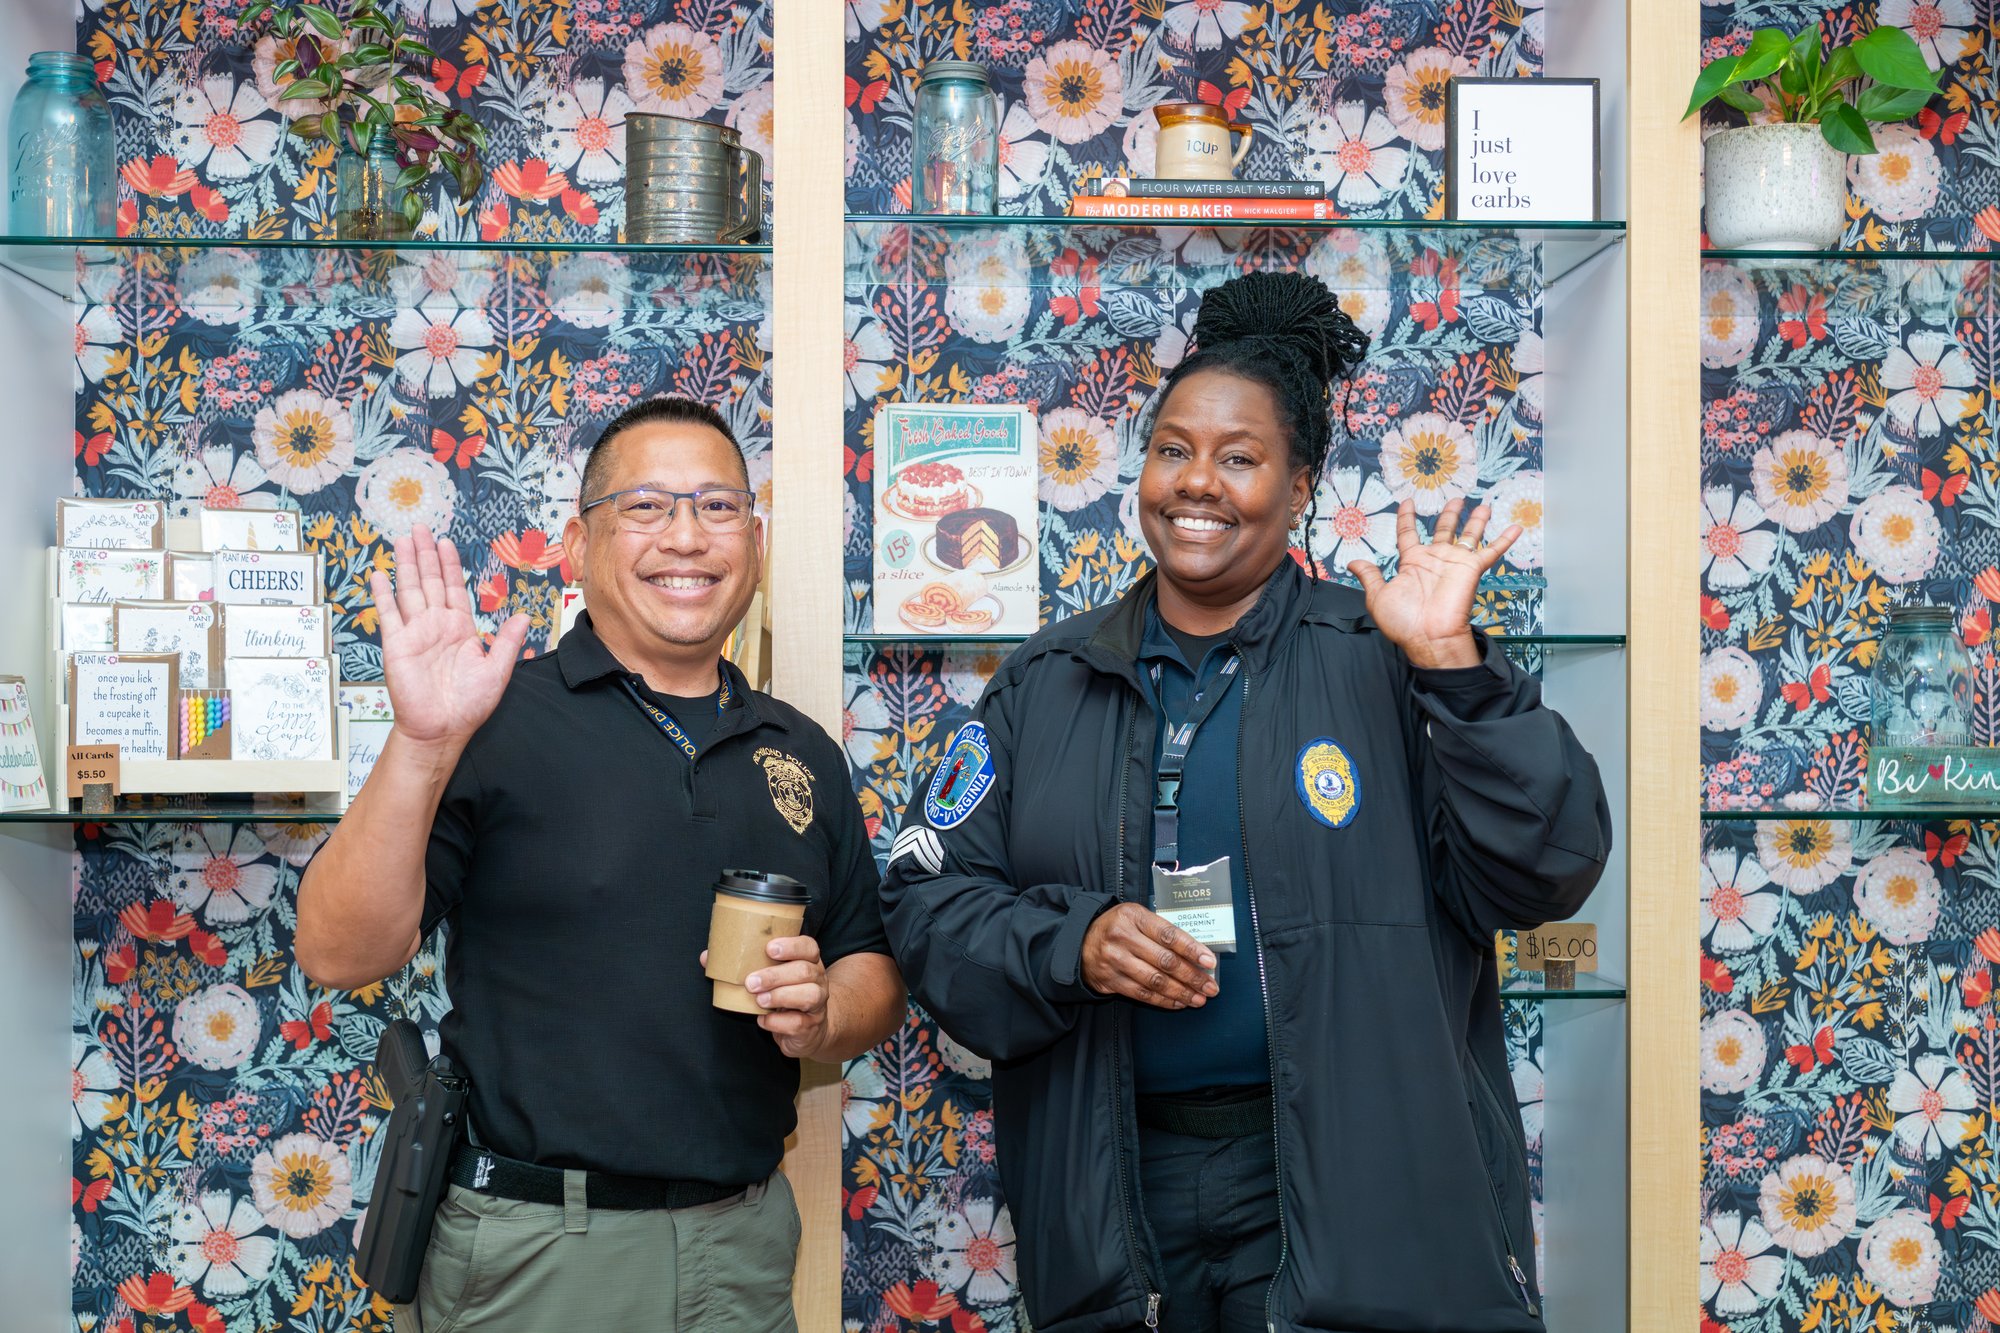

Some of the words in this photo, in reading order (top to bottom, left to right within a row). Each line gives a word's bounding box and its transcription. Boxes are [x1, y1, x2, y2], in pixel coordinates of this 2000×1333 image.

[1472, 110, 1480, 130] I
[1470, 133, 1513, 159] just
[1472, 162, 1517, 184] love
[1142, 183, 1181, 193] FLOUR
[1184, 184, 1223, 194] WATER
[1226, 185, 1252, 194] SALT
[1257, 185, 1293, 194] YEAST
[1472, 187, 1531, 208] carbs
[1085, 203, 1101, 217] the
[1102, 203, 1173, 217] MODERN
[1180, 205, 1233, 217] BAKER
[898, 418, 930, 459] Fresh
[930, 418, 971, 445] Baked
[974, 418, 1008, 444] Goods
[968, 466, 988, 478] BEST
[990, 466, 1001, 478] IN
[1004, 466, 1032, 478] TOWN!
[69, 551, 87, 559] PLANT
[222, 553, 239, 562] PLANT
[241, 554, 249, 562] ME
[229, 569, 304, 591] CHEERS!
[877, 572, 886, 580] a
[890, 569, 925, 580] slice
[244, 629, 306, 654] thinking
[77, 655, 96, 665] PLANT
[97, 656, 107, 665] ME
[97, 675, 118, 683] once
[120, 675, 135, 686] you
[137, 669, 153, 683] lick
[305, 669, 327, 677] PLANT
[93, 687, 108, 701] the
[109, 687, 143, 704] frosting
[144, 687, 158, 701] off
[106, 705, 141, 723] cupcake
[143, 706, 150, 719] it
[266, 701, 313, 730] happy
[86, 722, 123, 736] becomes
[124, 728, 130, 736] a
[131, 722, 162, 736] muffin.
[255, 721, 321, 751] Couple
[70, 752, 84, 760] All
[85, 751, 114, 761] Cards
[121, 745, 129, 753] re
[131, 739, 165, 756] healthy.
[77, 769, 106, 780] $5.50
[1877, 756, 1931, 794] Be
[1944, 755, 2000, 791] Kin
[1172, 888, 1211, 899] TAYLORS
[1177, 912, 1210, 921] ORGANIC
[1525, 932, 1597, 960] $15.00
